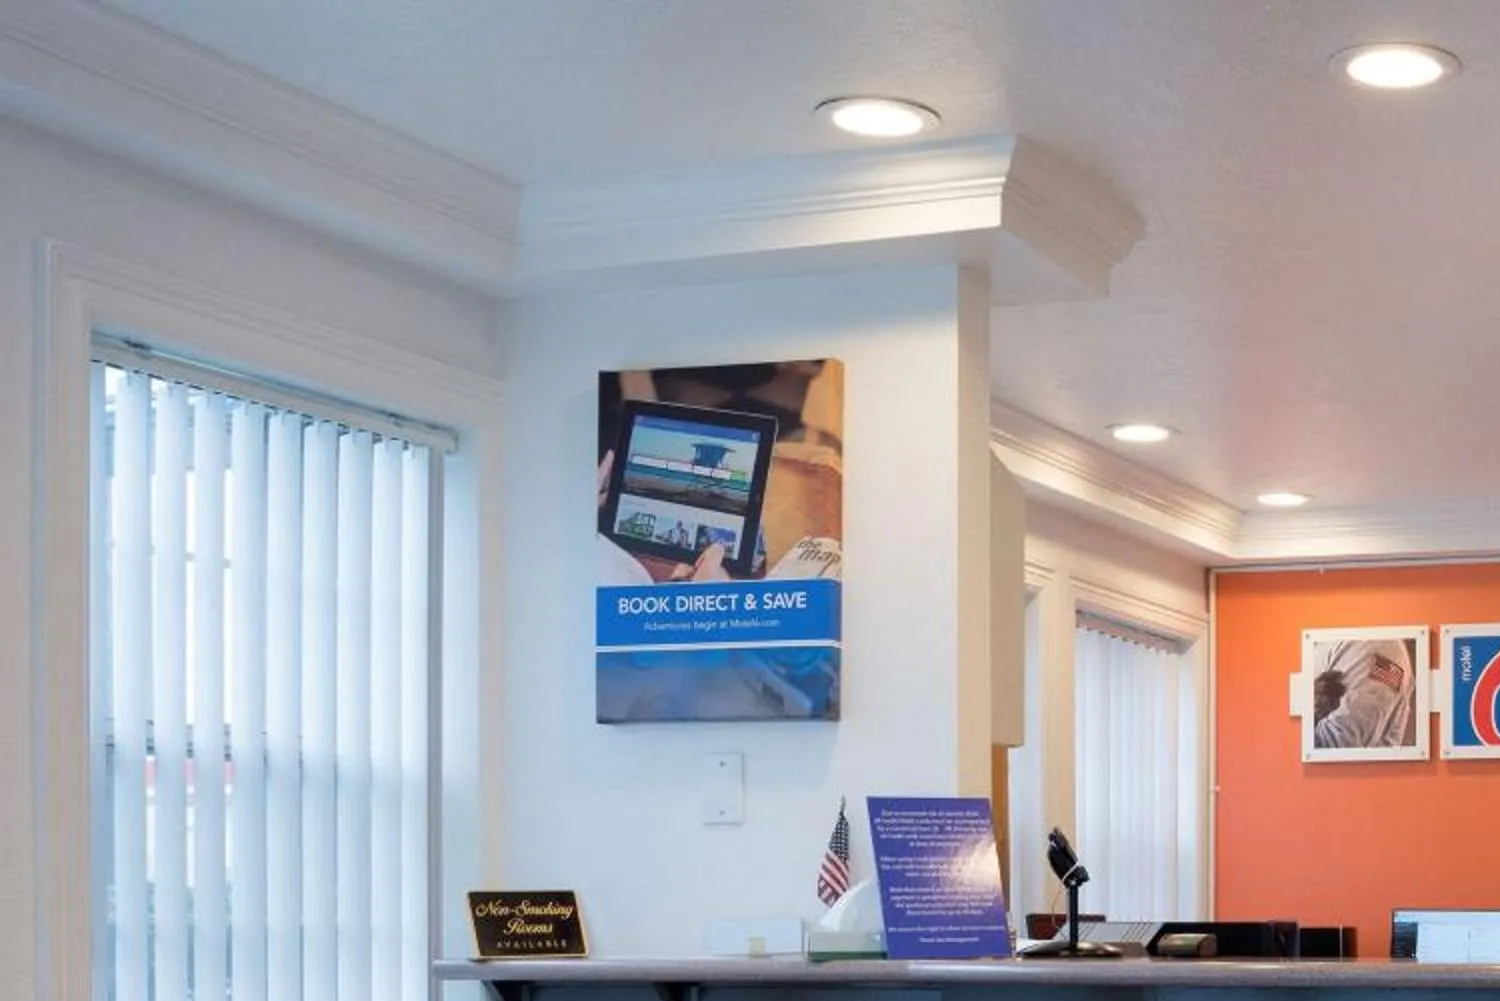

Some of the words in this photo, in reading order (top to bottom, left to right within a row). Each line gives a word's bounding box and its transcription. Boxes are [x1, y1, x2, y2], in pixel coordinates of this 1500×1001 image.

[618, 596, 671, 615] BOOK
[675, 594, 738, 612] DIRECT
[744, 593, 757, 610] &
[763, 591, 807, 610] SAVE
[693, 619, 718, 632] begin
[720, 620, 728, 629] at
[1460, 645, 1472, 682] motel
[475, 899, 574, 920] Non-Smoking
[503, 917, 554, 935] Rooms
[495, 939, 568, 950] AVAILABLE
